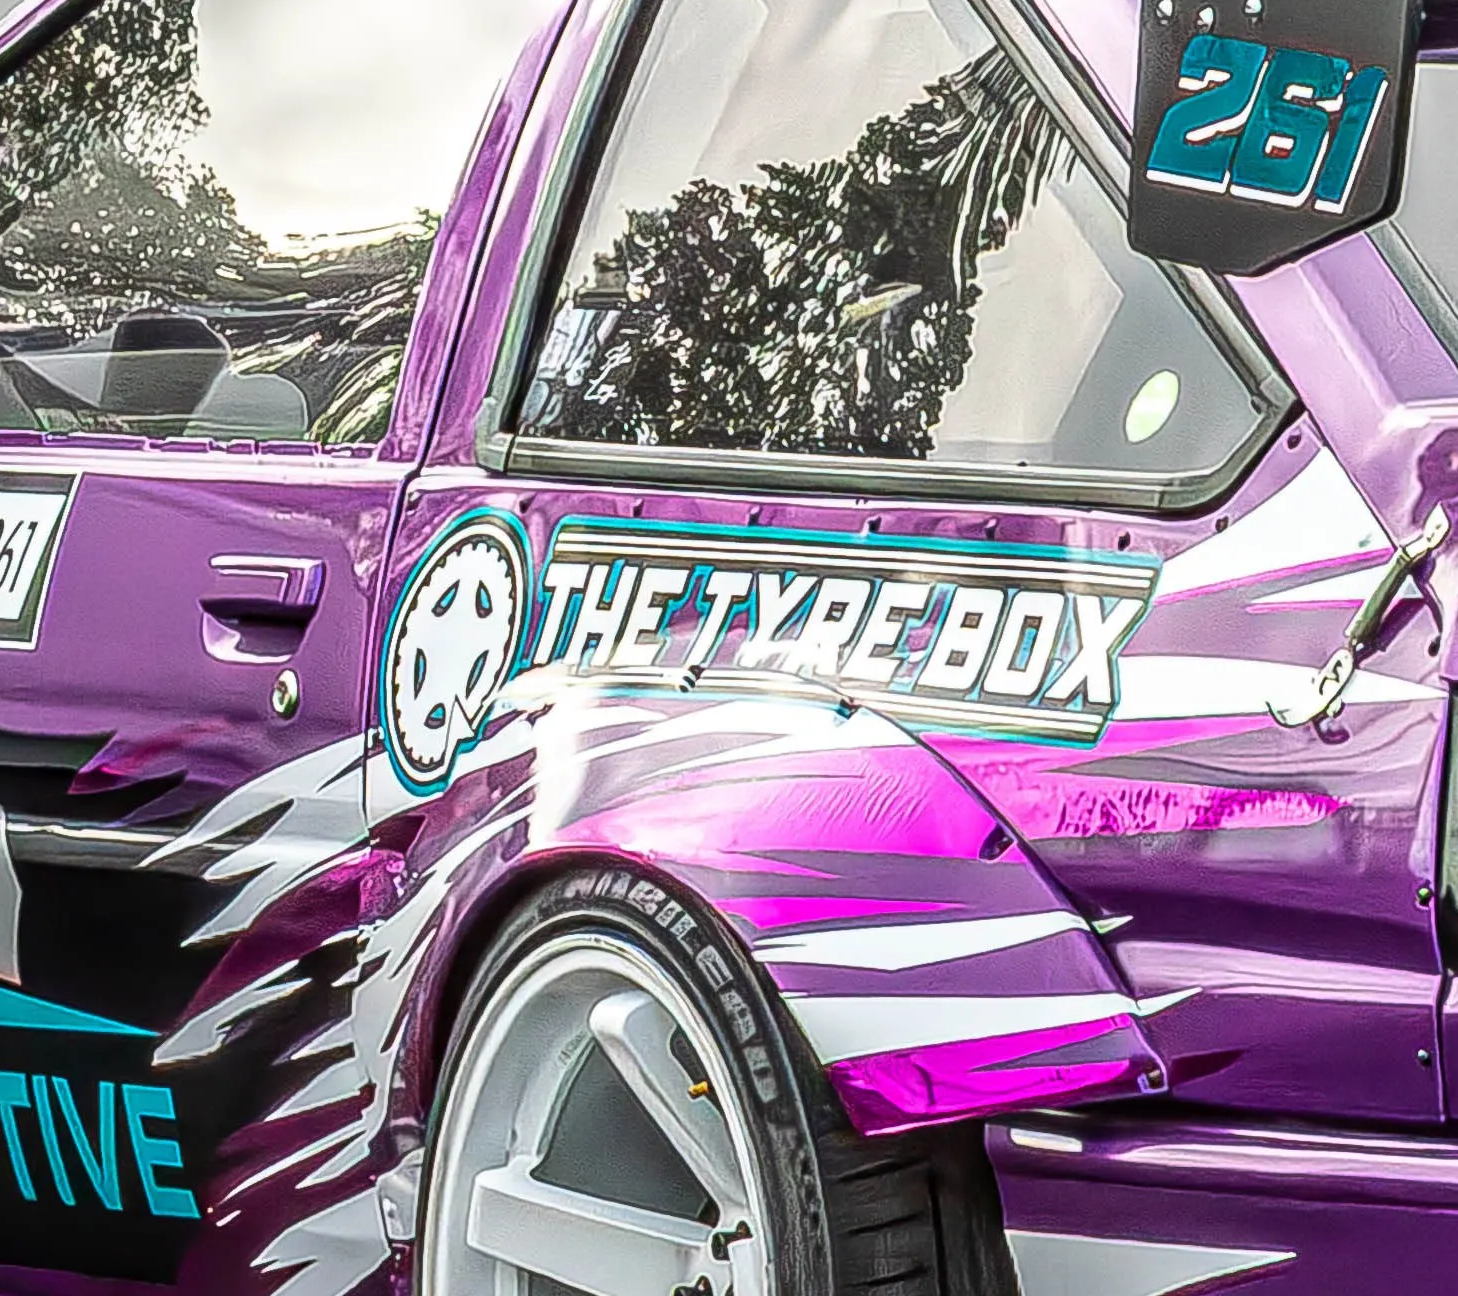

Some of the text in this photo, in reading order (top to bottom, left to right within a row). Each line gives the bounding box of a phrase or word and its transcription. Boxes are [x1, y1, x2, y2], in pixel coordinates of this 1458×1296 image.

[1145, 34, 1389, 215] 261
[533, 559, 1146, 704] THE TYRE BOX
